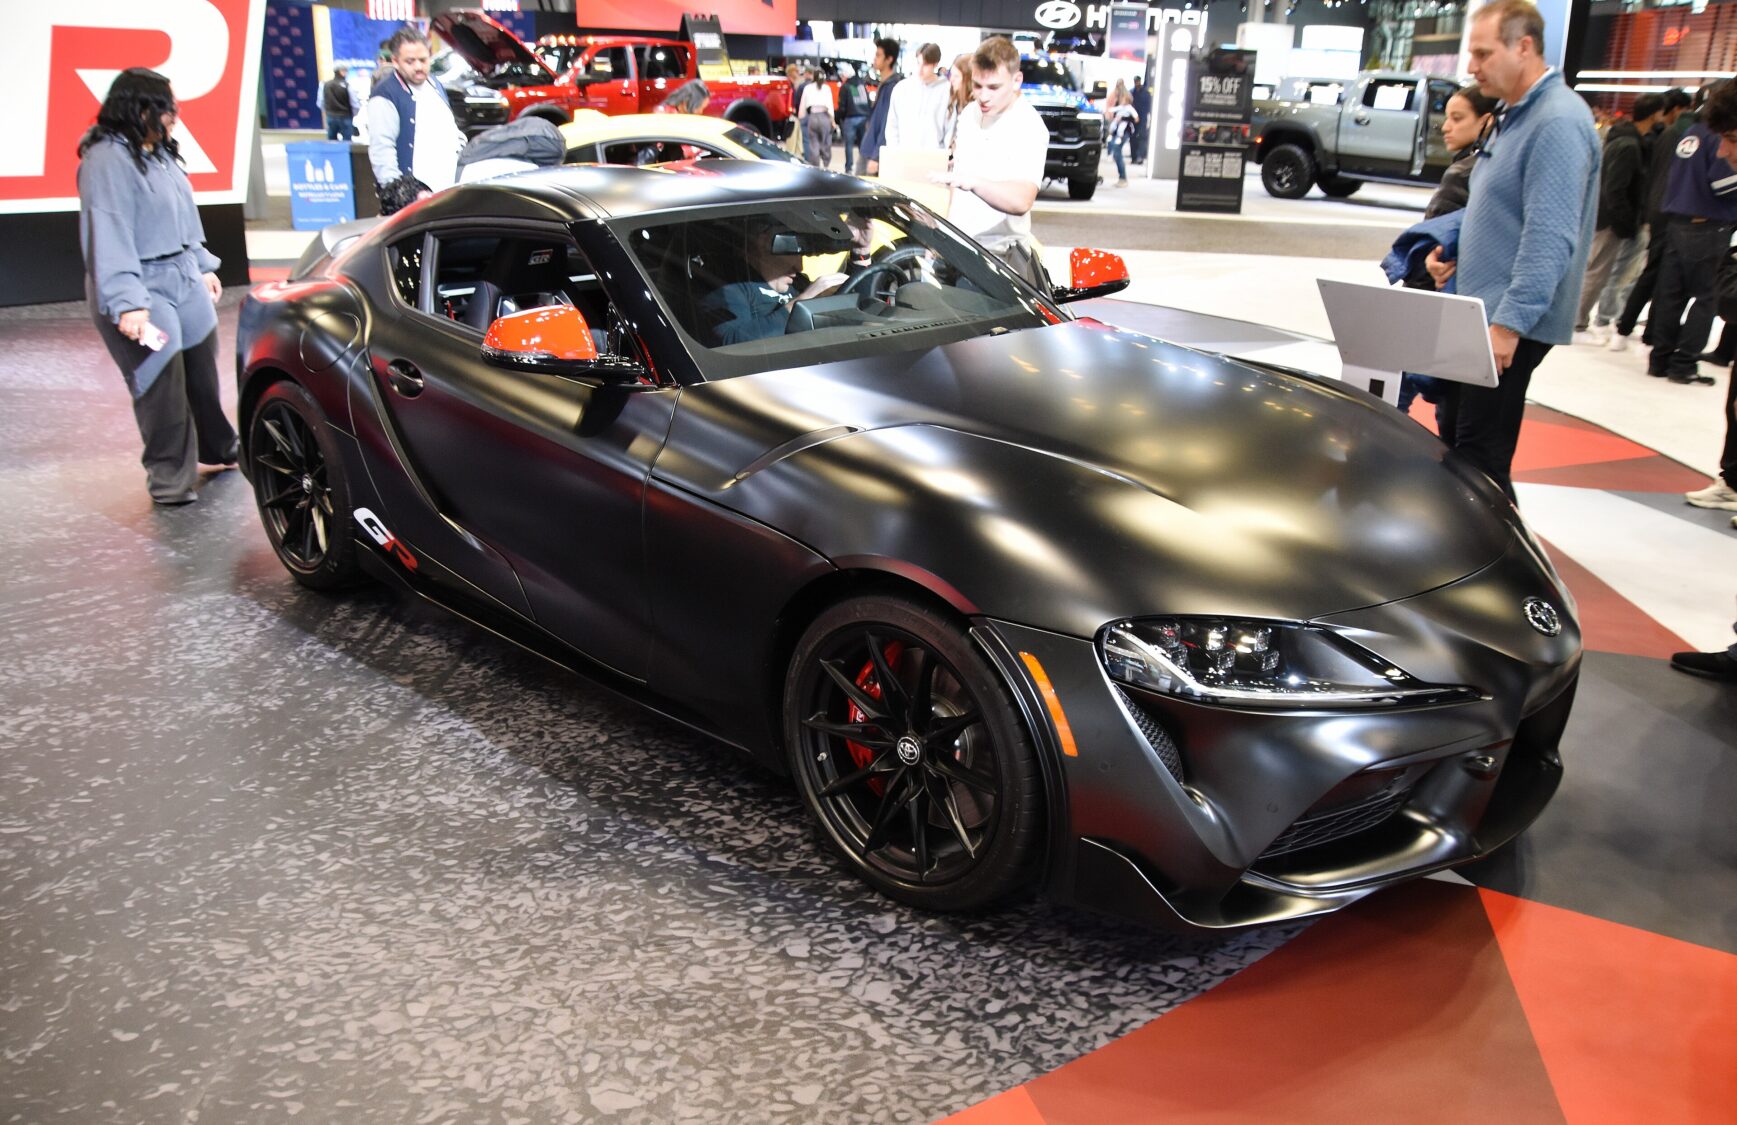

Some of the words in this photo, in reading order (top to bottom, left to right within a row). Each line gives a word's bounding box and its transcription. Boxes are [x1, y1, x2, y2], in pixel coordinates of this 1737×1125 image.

[1200, 76, 1221, 93] 15%
[1222, 76, 1242, 94] OFF
[353, 507, 418, 573] GR
